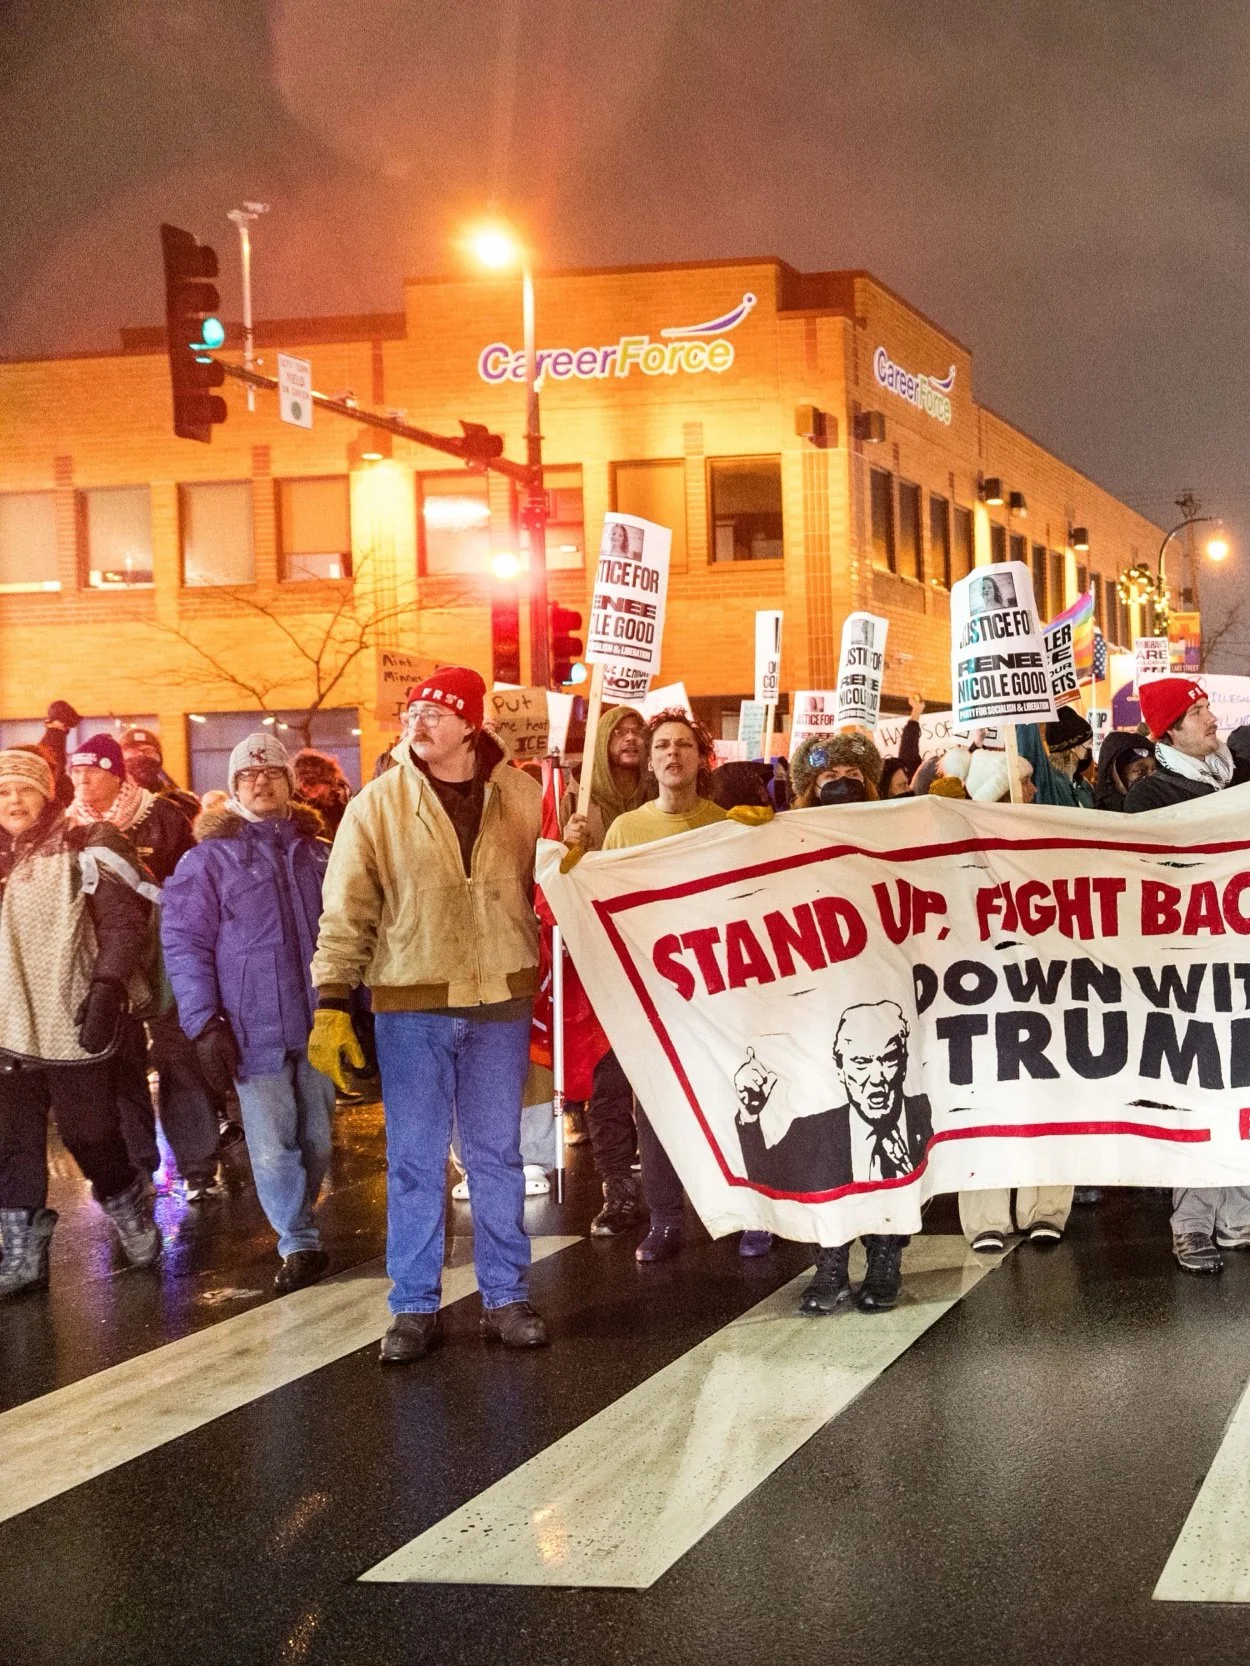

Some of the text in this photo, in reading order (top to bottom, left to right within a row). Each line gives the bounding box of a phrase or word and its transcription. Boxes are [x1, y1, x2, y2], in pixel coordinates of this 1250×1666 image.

[480, 337, 732, 381] CareerForce
[875, 348, 950, 424] CareerForce
[598, 560, 660, 594] TICE FOR
[613, 617, 655, 645] GOOD
[957, 652, 1043, 678] RENEE
[1047, 645, 1072, 665] E
[1135, 649, 1168, 660] ARE
[1183, 664, 1199, 672] STREET
[421, 687, 465, 711] FRSO
[958, 671, 1048, 704] NICOLE GOOD
[820, 714, 835, 726] FOR
[987, 703, 1016, 716] SOCIALISM
[1016, 702, 1024, 712] &
[1024, 700, 1050, 712] LIBERATION
[515, 735, 548, 753] ICE
[652, 896, 868, 1002] STAND
[871, 877, 951, 945] UP,
[976, 877, 1126, 941] FIGHT
[913, 957, 1122, 1016] DOWN
